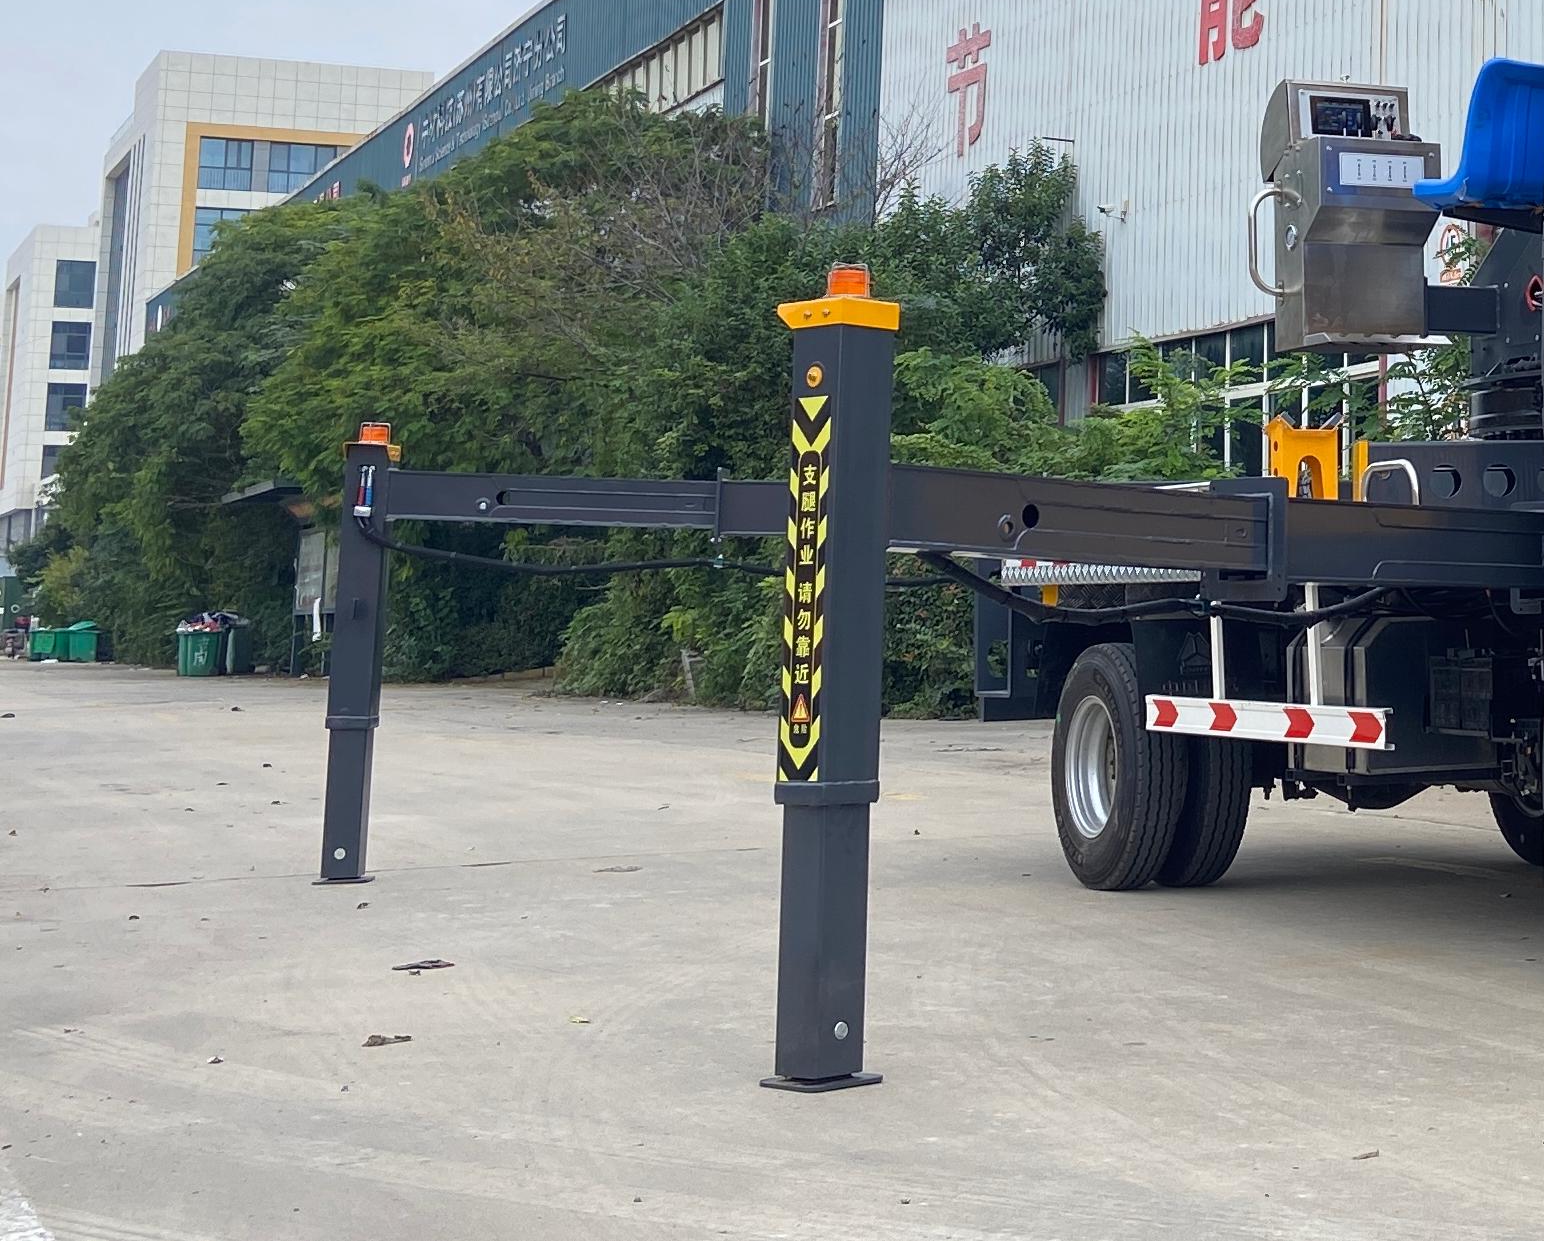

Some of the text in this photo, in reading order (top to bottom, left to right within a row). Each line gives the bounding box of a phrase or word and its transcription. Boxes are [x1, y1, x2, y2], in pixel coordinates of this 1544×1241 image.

[794, 463, 818, 685] 支腿作业 请勿靠近
